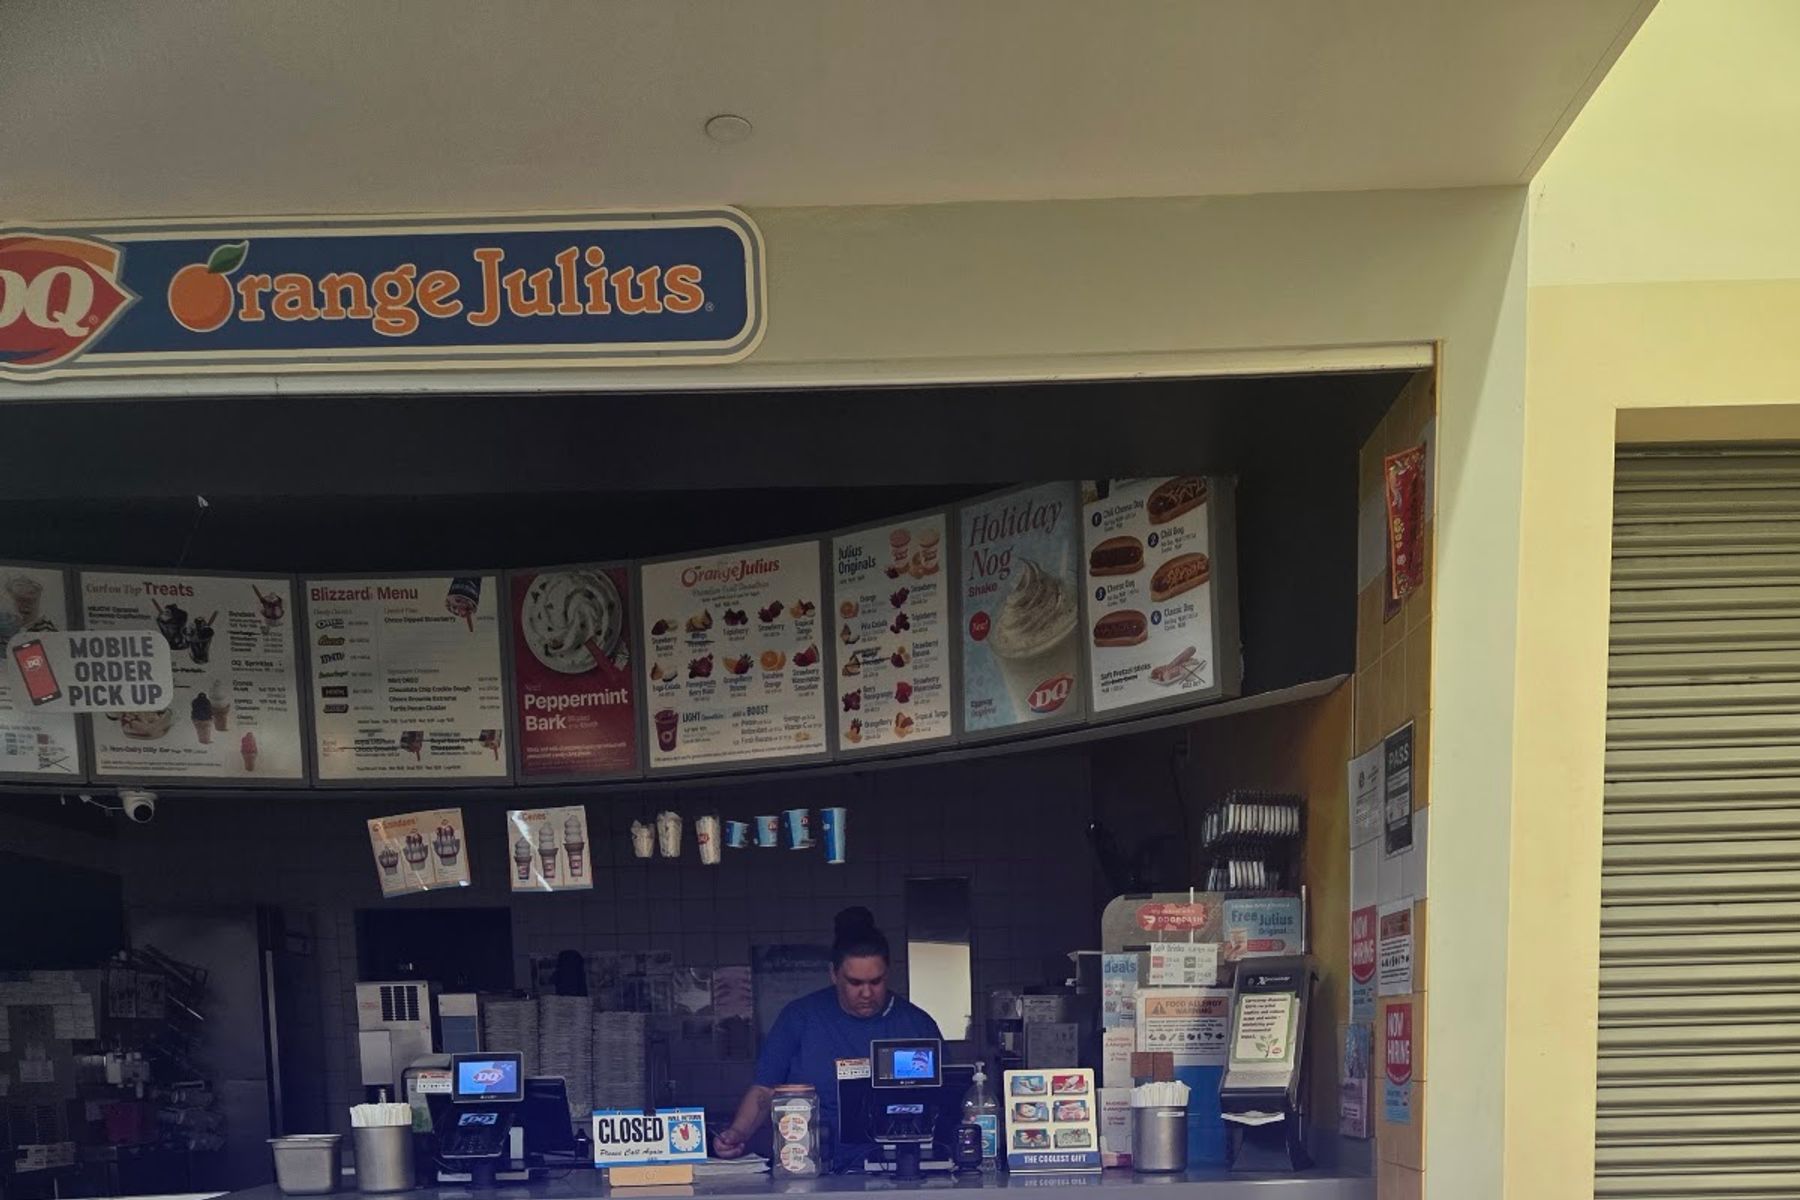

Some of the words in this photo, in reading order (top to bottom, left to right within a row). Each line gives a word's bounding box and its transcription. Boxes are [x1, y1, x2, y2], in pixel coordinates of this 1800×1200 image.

[467, 245, 706, 327] Julius
[968, 499, 1063, 548] Holiday
[838, 545, 864, 561] Julius
[968, 545, 1015, 581] Nog
[681, 566, 740, 588] Orange
[736, 558, 780, 581] Julius
[838, 556, 876, 576] Originals
[143, 582, 194, 597] Treats
[311, 586, 370, 601] Blizzard
[377, 586, 418, 600] Menu
[968, 582, 998, 597] Shake
[69, 636, 155, 659] MOBILE
[75, 660, 155, 682] ORDER
[69, 684, 124, 707] PICK
[131, 684, 163, 705] UP
[524, 688, 629, 712] Peppermint
[1036, 679, 1070, 708] DQ
[525, 714, 567, 731] Bark
[682, 711, 701, 723] LIGHT
[1231, 910, 1258, 922] Free
[1259, 912, 1294, 926] Julius
[1104, 961, 1137, 974] deals
[1165, 1000, 1186, 1008] FOOD
[1188, 999, 1223, 1009] ALLERGY
[1387, 1011, 1404, 1038] NOW
[1387, 1039, 1411, 1064] HIRING
[479, 1072, 500, 1082] DQ
[599, 1117, 664, 1144] CLOSED
[600, 1148, 621, 1157] Please
[624, 1147, 640, 1156] Call
[642, 1147, 664, 1156] Again
[1024, 1155, 1038, 1164] THE
[1039, 1155, 1069, 1164] COOLEST
[1070, 1154, 1087, 1163] GIFT
